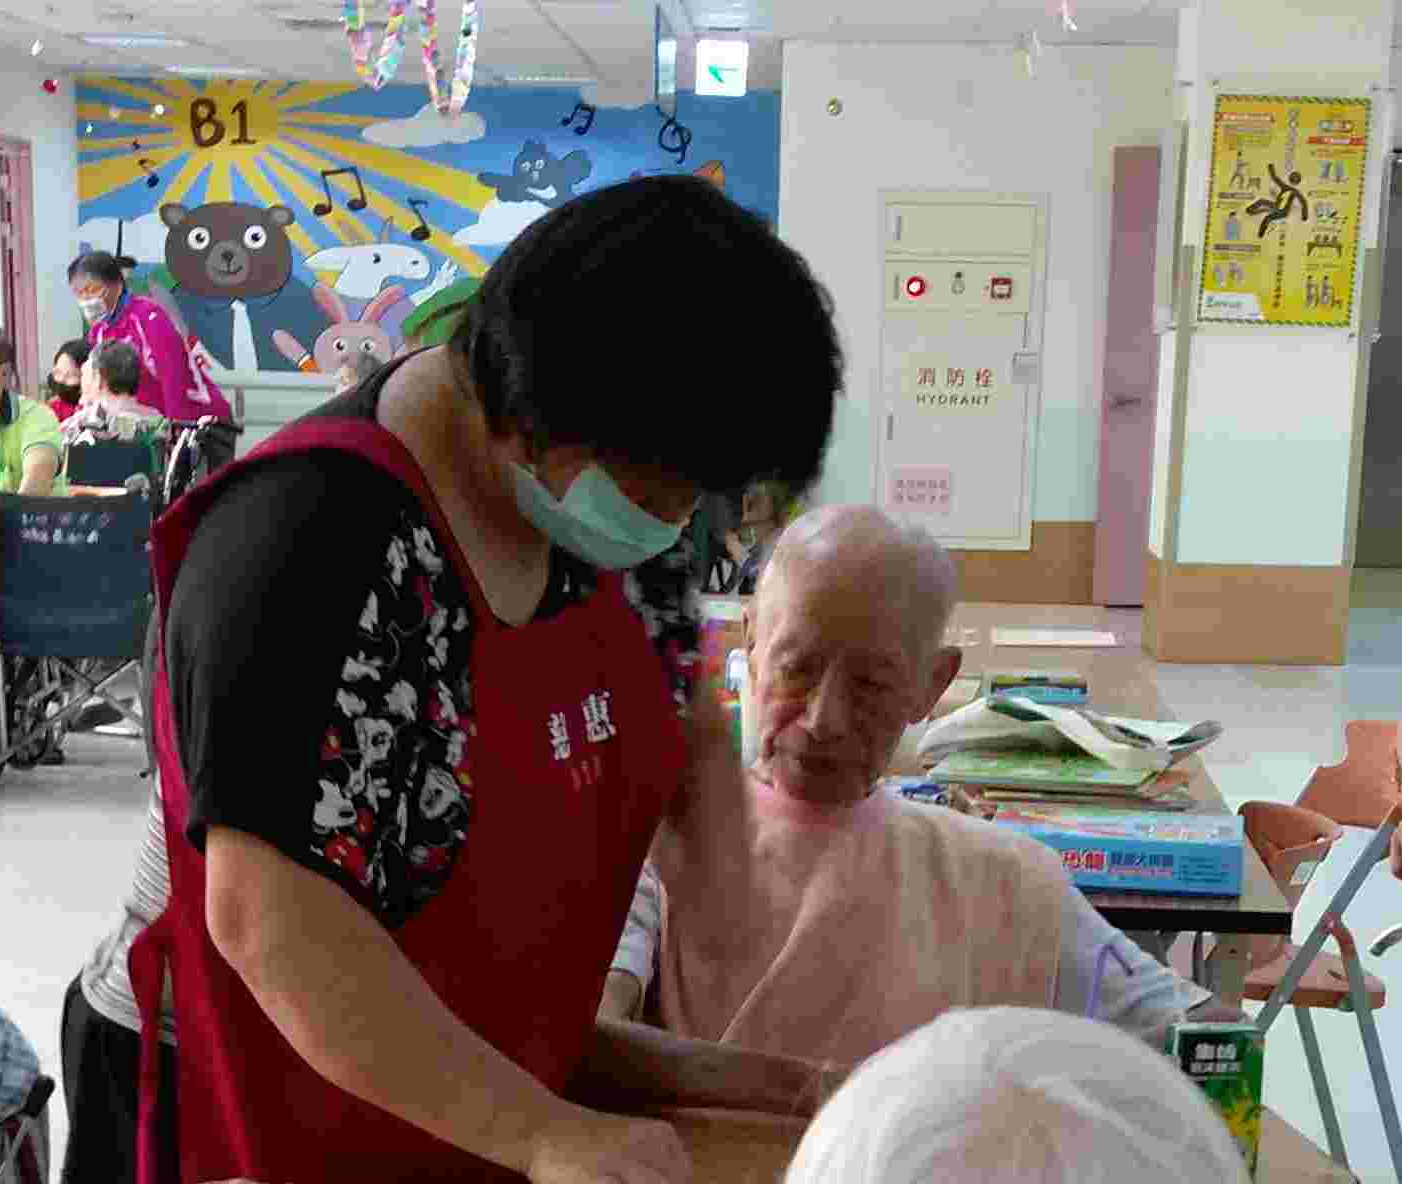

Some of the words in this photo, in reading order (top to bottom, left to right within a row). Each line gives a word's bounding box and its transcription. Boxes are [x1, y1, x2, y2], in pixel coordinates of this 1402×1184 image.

[189, 97, 256, 148] B1
[916, 366, 994, 387] 消防栓
[916, 392, 990, 406] HYDRANT
